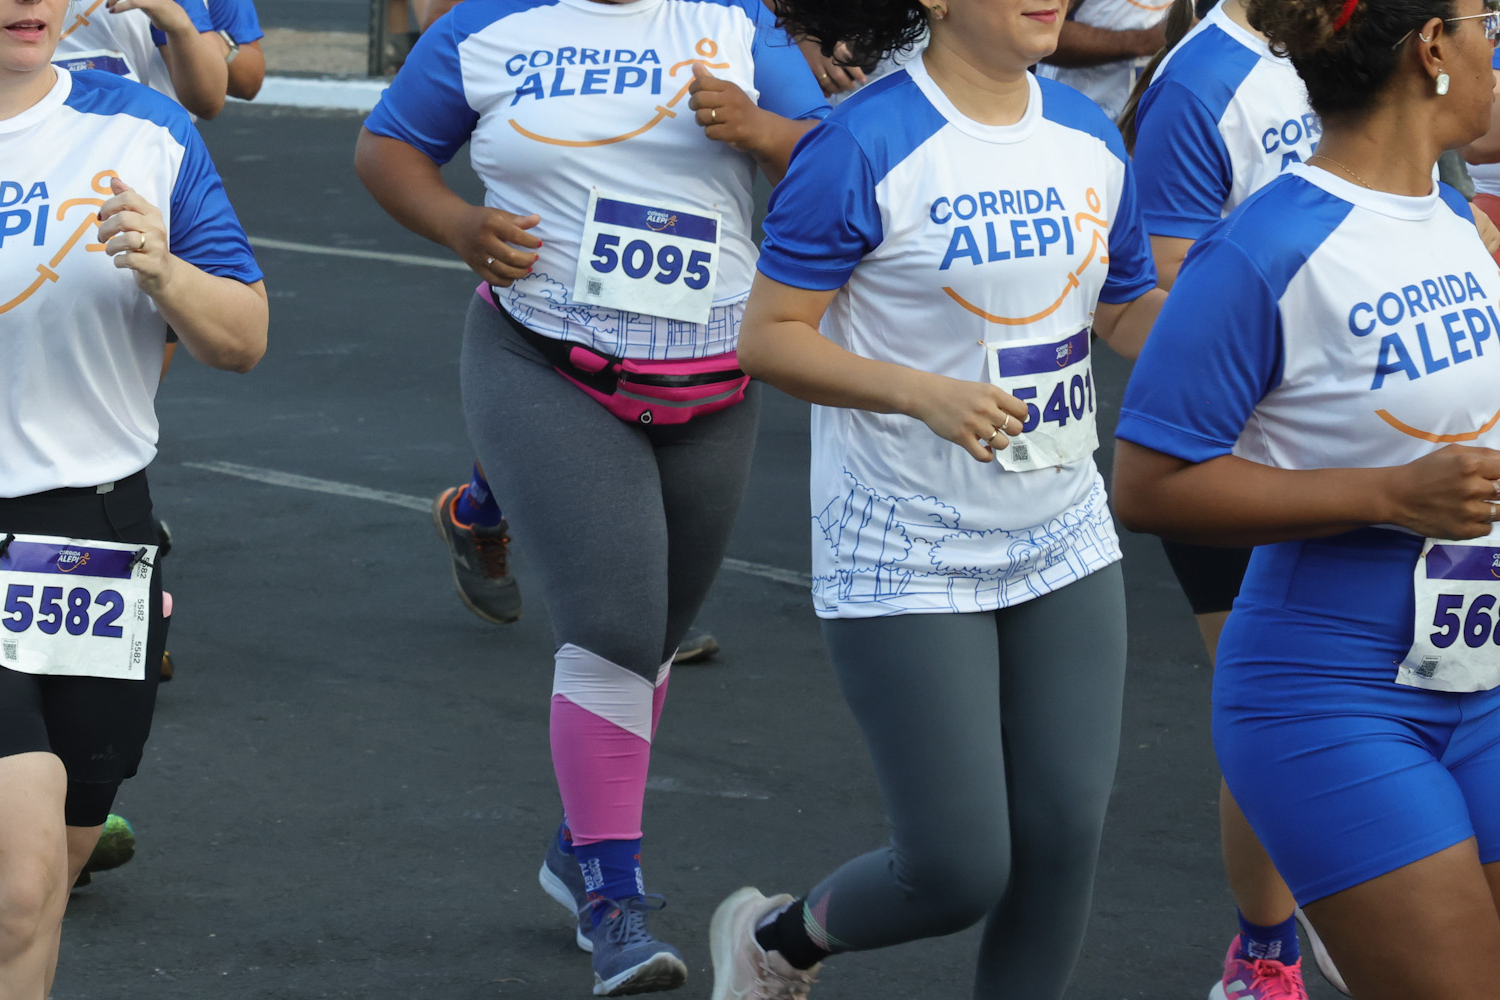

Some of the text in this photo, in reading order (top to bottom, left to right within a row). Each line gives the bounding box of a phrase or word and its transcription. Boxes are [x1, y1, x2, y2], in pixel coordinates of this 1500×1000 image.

[505, 46, 661, 76] CORRIDA
[510, 66, 663, 107] ALEPI
[646, 215, 668, 225] ALEPI
[930, 187, 1066, 225] CORRIDA
[590, 232, 712, 290] 5095
[938, 216, 1074, 270] ALEPI
[1348, 271, 1488, 338] CORRIDA
[1012, 367, 1093, 433] 5401
[57, 554, 79, 563] ALEPI
[1, 583, 125, 639] 5582
[136, 598, 144, 621] 5582
[1430, 593, 1500, 648] 56
[133, 641, 142, 664] 5582
